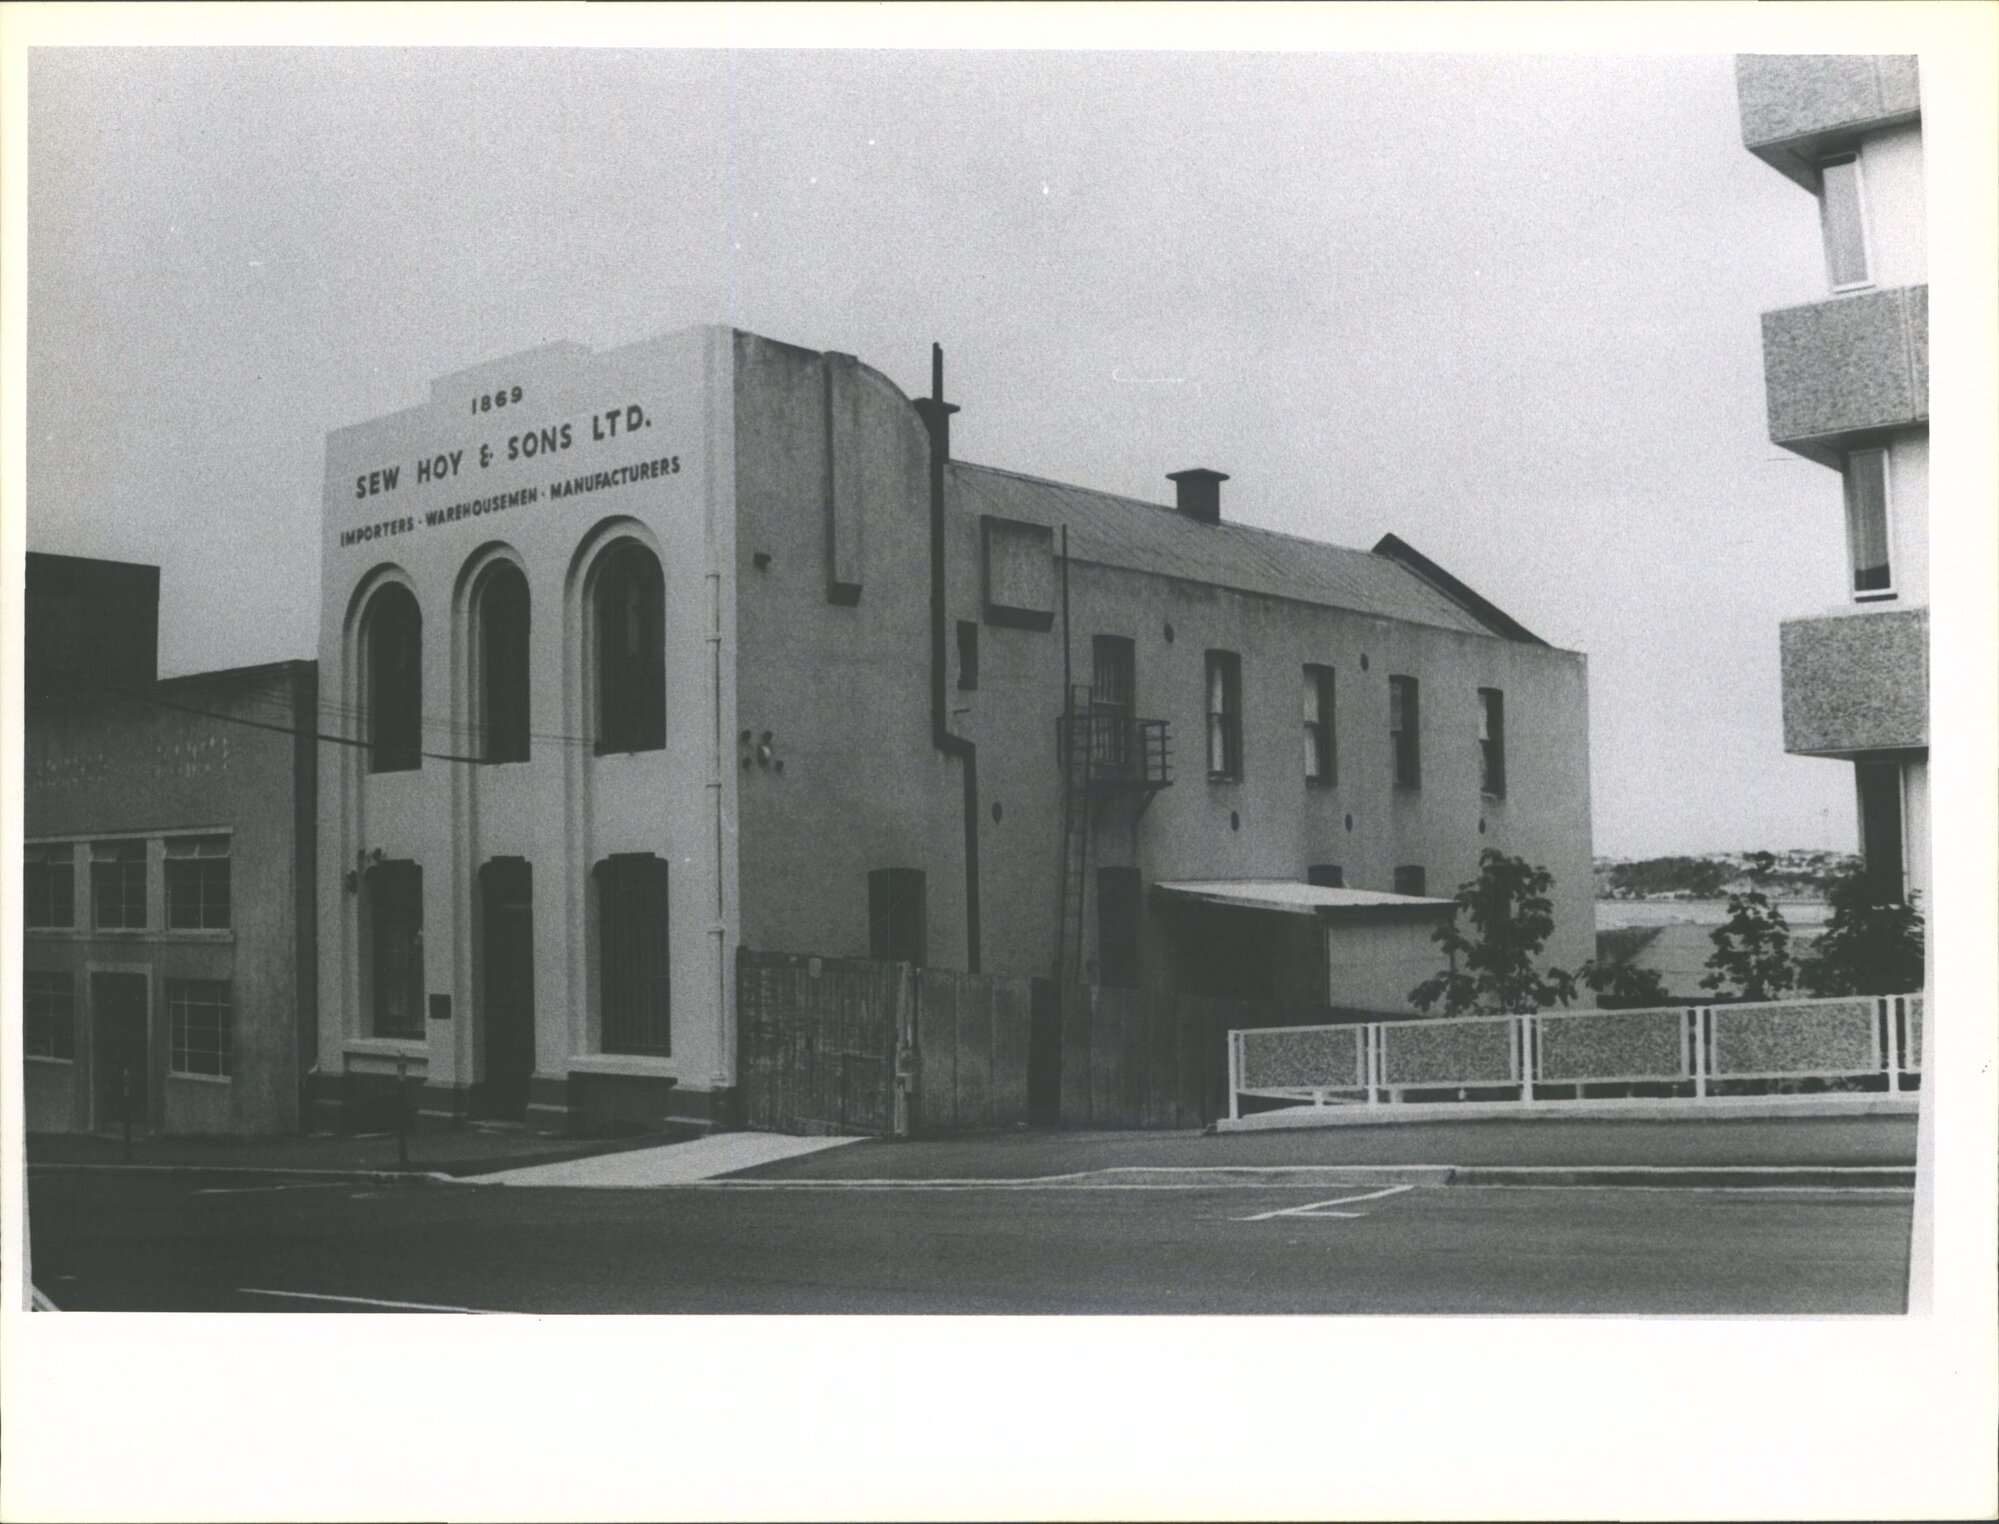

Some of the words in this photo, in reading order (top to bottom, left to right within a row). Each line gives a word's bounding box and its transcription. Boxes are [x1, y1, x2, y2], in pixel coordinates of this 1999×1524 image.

[471, 386, 523, 415] 1869
[356, 466, 401, 499] SEW
[417, 450, 463, 484] HOY
[479, 443, 494, 469] &
[507, 423, 573, 461] SONS
[592, 404, 652, 441] LTD.
[340, 516, 415, 548] IMPORTERS
[426, 487, 538, 528] WAREHOUSEMEN
[550, 455, 682, 500] MANUFACTURERS
